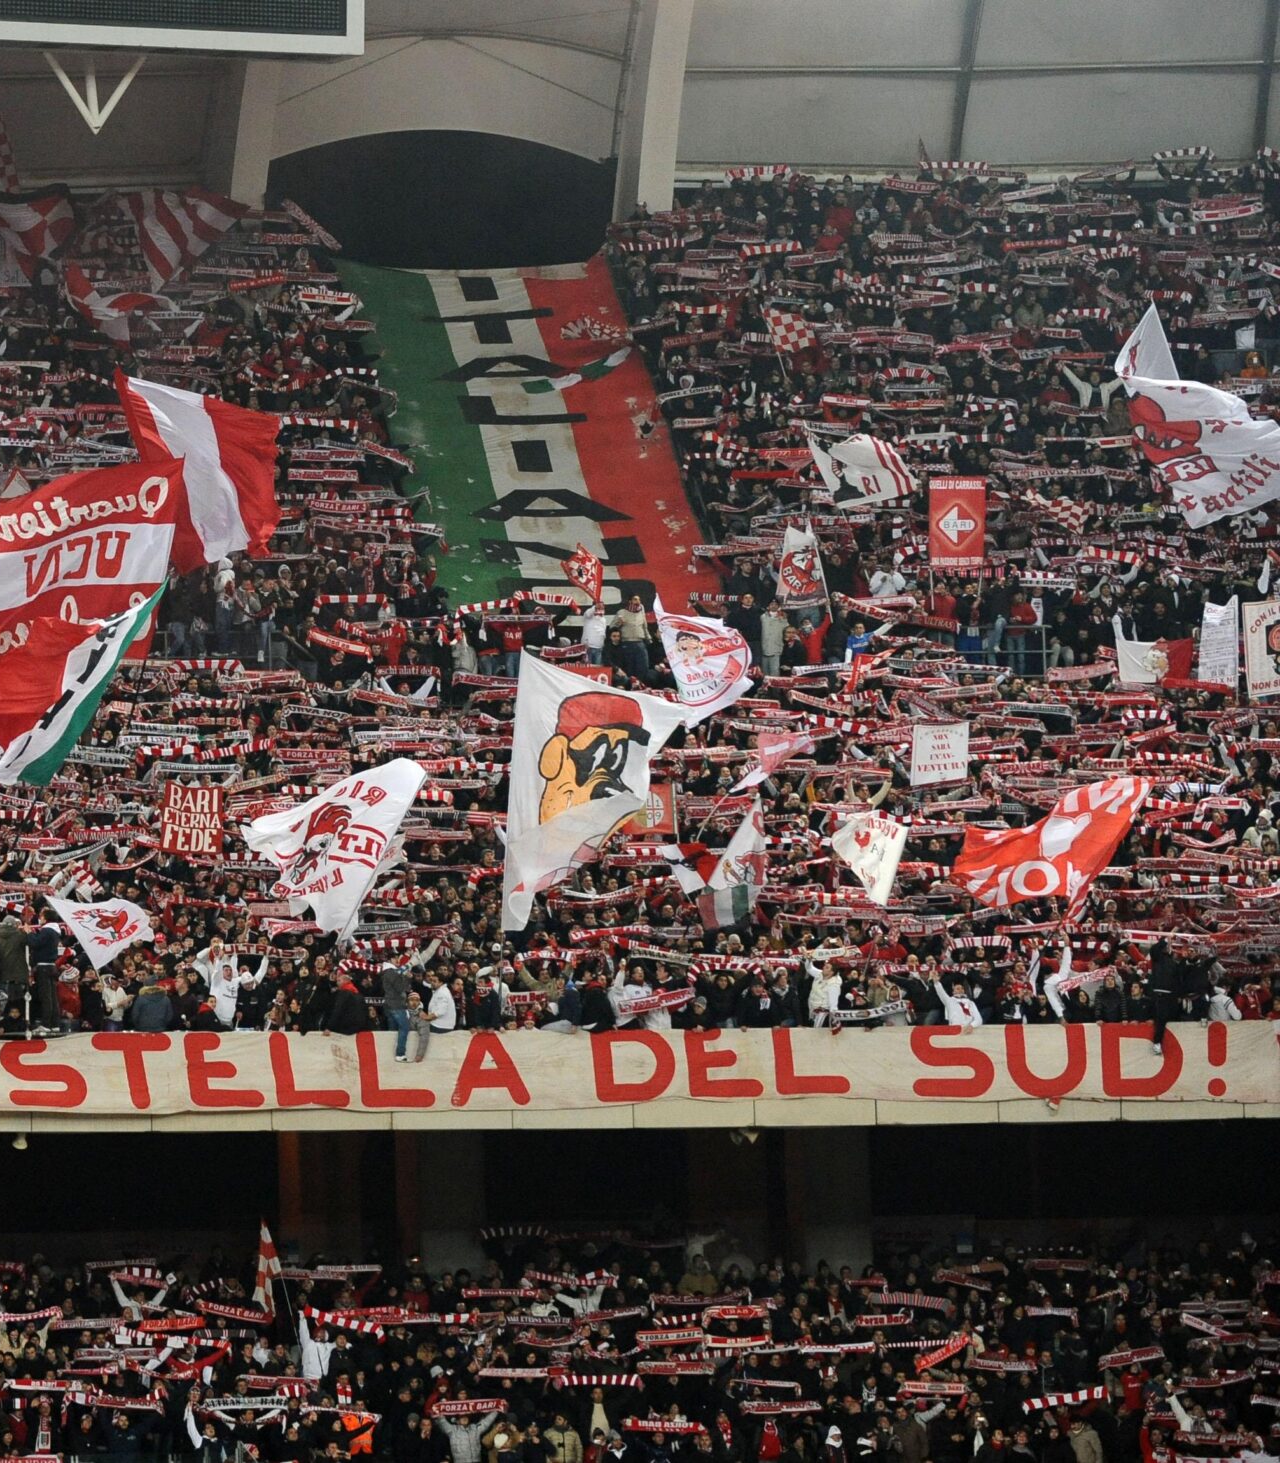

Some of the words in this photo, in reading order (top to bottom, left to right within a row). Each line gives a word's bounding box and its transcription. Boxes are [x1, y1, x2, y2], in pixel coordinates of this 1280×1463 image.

[311, 501, 337, 510] FORZA
[341, 503, 361, 511] BARI
[942, 521, 972, 529] BARI
[1250, 612, 1269, 634] CON
[1251, 680, 1270, 691] NON
[286, 751, 313, 760] FORZA
[170, 783, 219, 813] BARI
[163, 808, 222, 829] ETERNA
[162, 829, 218, 853] FEDE
[223, 943, 294, 958] ULTRAS
[817, 951, 843, 960] BARI
[0, 1029, 531, 1109] STELLA
[591, 1027, 851, 1102] DEL
[910, 1022, 1227, 1097] SUD!
[208, 1303, 236, 1313] FORZA
[242, 1310, 265, 1319] BARI
[646, 1333, 670, 1342] FORZA
[675, 1332, 696, 1340] BARI
[439, 1403, 468, 1413] FORZA
[476, 1401, 497, 1411] BARI
